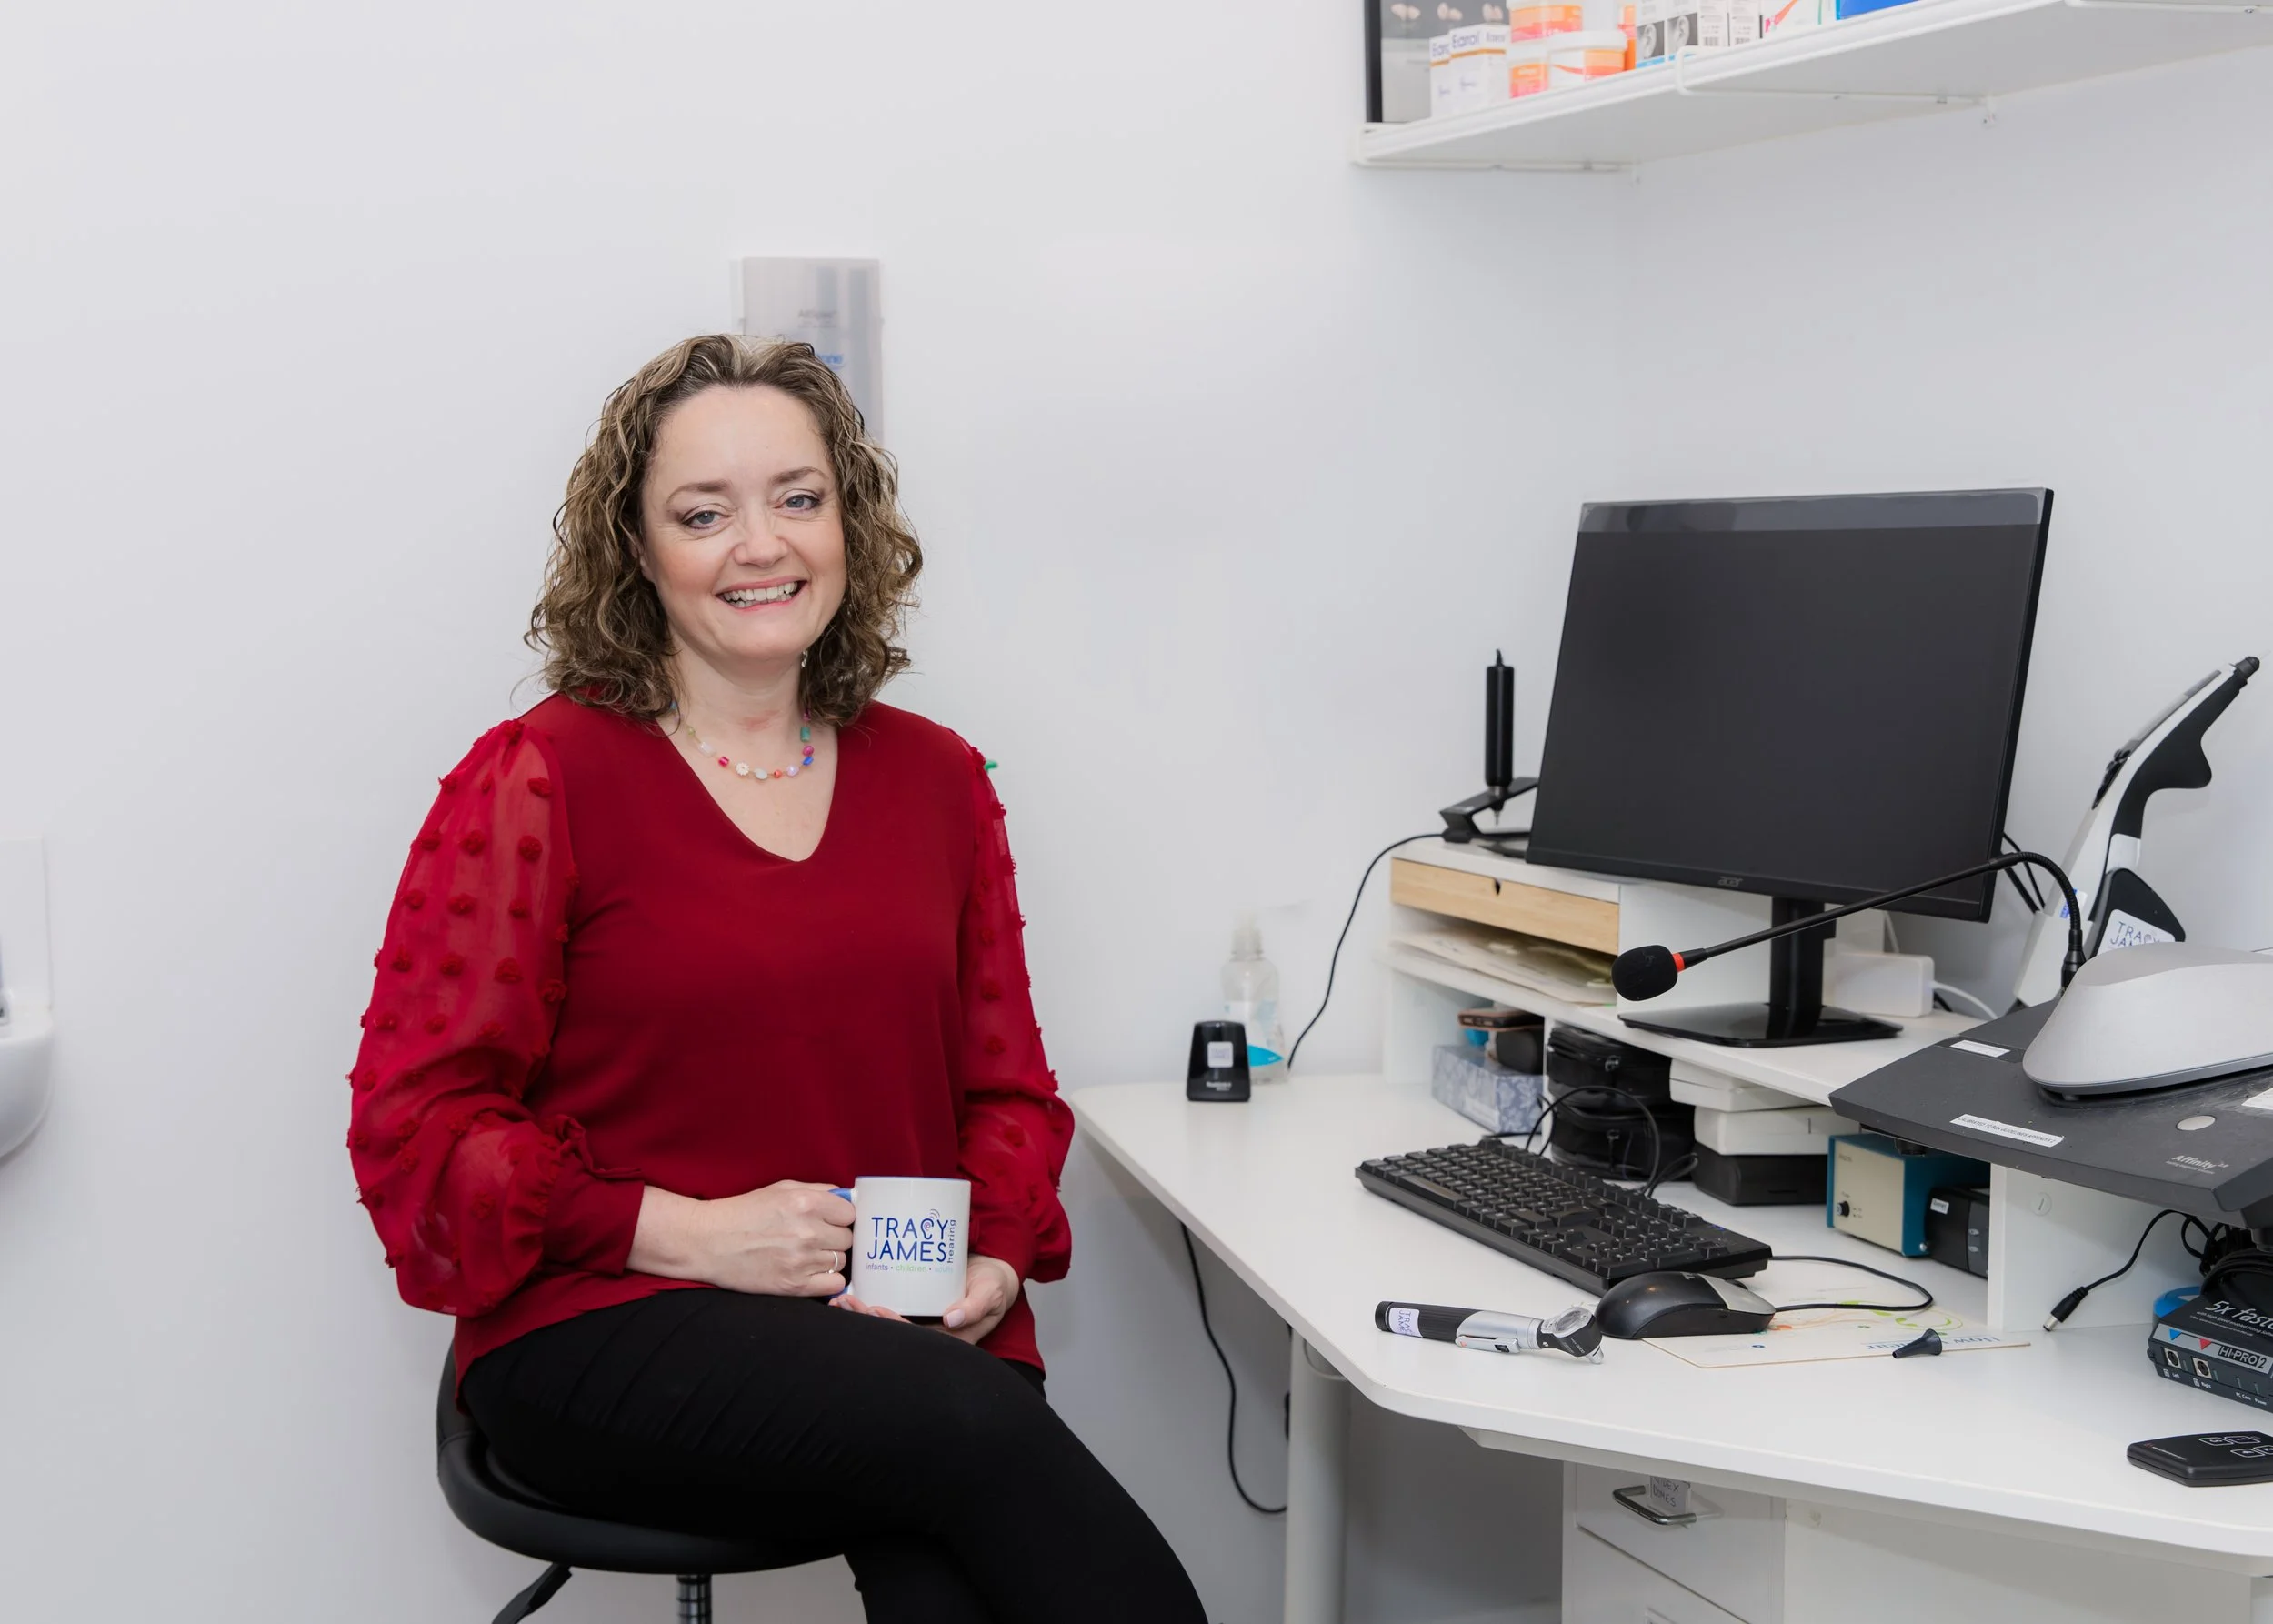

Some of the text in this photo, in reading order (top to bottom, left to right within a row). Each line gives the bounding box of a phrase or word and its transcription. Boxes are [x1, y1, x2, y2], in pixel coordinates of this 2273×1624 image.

[1451, 30, 1481, 49] Earol
[1717, 876, 1744, 888] acer
[2171, 1155, 2217, 1170] Affinity
[871, 1216, 949, 1240] TRACY
[946, 1218, 957, 1264] hearing
[867, 1239, 946, 1263] JAMES
[866, 1263, 889, 1272] infants
[895, 1263, 927, 1272] children
[2204, 1300, 2237, 1315] 5x
